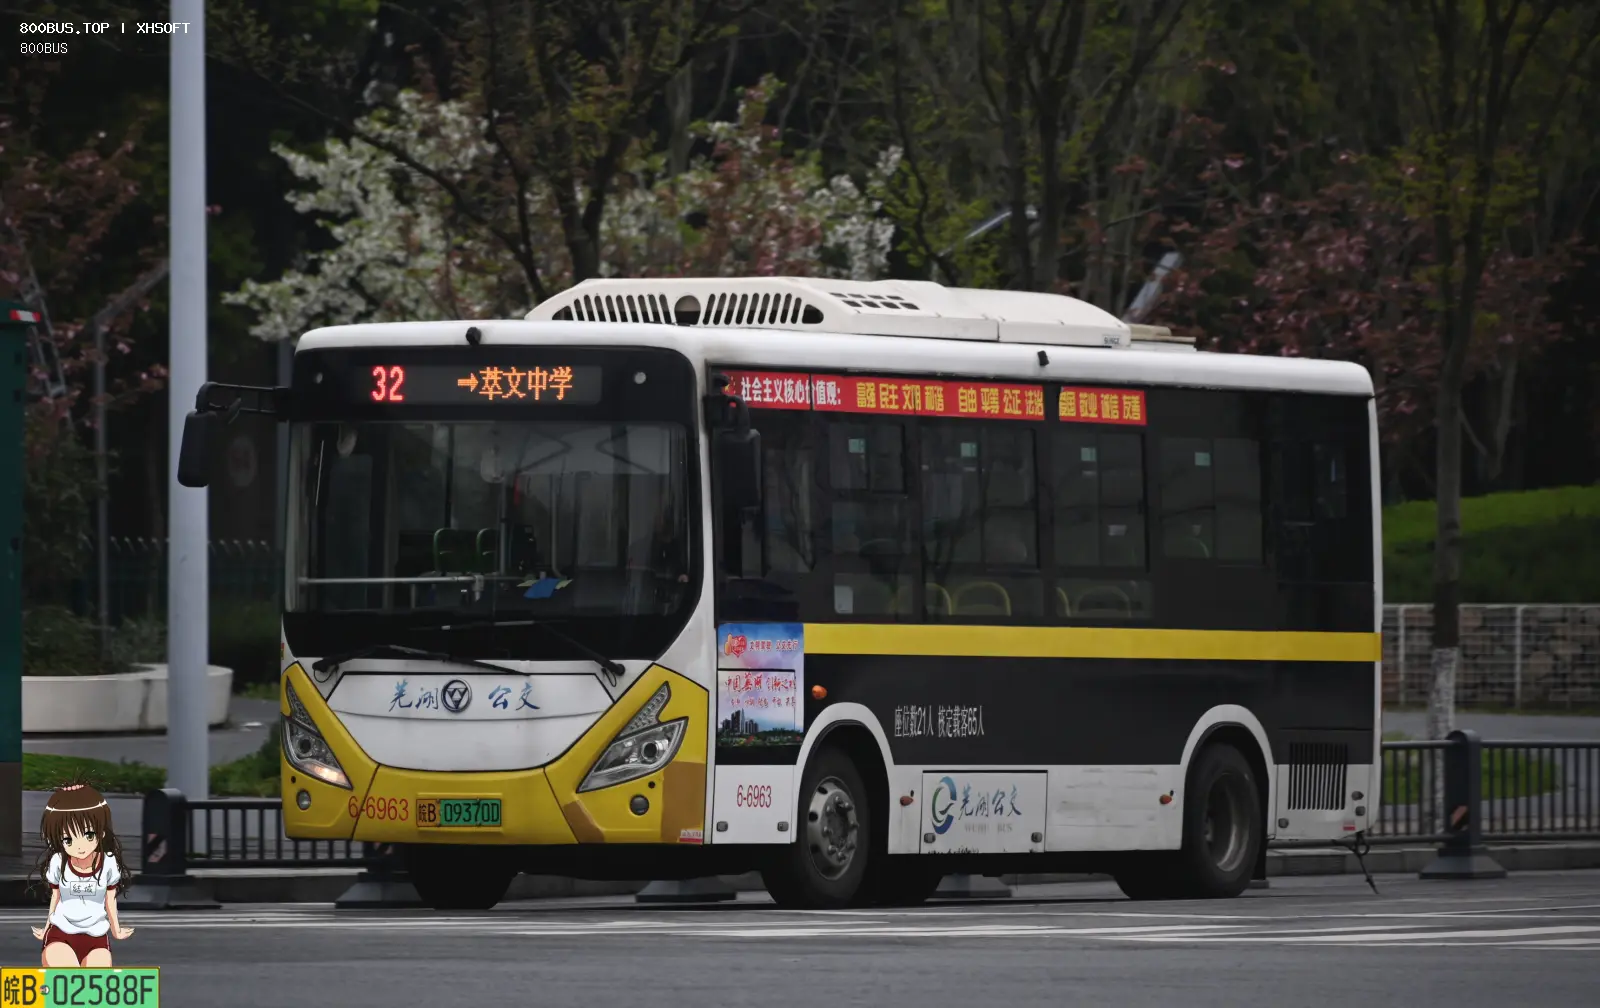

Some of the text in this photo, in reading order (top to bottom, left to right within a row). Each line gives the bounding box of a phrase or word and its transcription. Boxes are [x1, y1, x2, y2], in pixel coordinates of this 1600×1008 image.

[371, 365, 404, 401] 32
[479, 366, 573, 401] 萃文中学
[856, 381, 876, 409] 富强
[879, 383, 899, 410] 民主
[902, 385, 922, 411] 文明
[924, 385, 945, 412] 和谐
[958, 387, 978, 413] 自由
[981, 388, 1000, 414] 平等
[1003, 389, 1022, 415] 公正
[1025, 390, 1044, 416] 法治
[1059, 391, 1076, 417] 爱国
[1079, 392, 1098, 418] 敬业
[1101, 393, 1119, 420] 诚信
[1122, 395, 1141, 420] 友善
[488, 681, 540, 711] 公交
[894, 705, 985, 737] 座位数21人 核定载客65人
[348, 795, 409, 821] 6-6963
[737, 784, 772, 808] 6-6963
